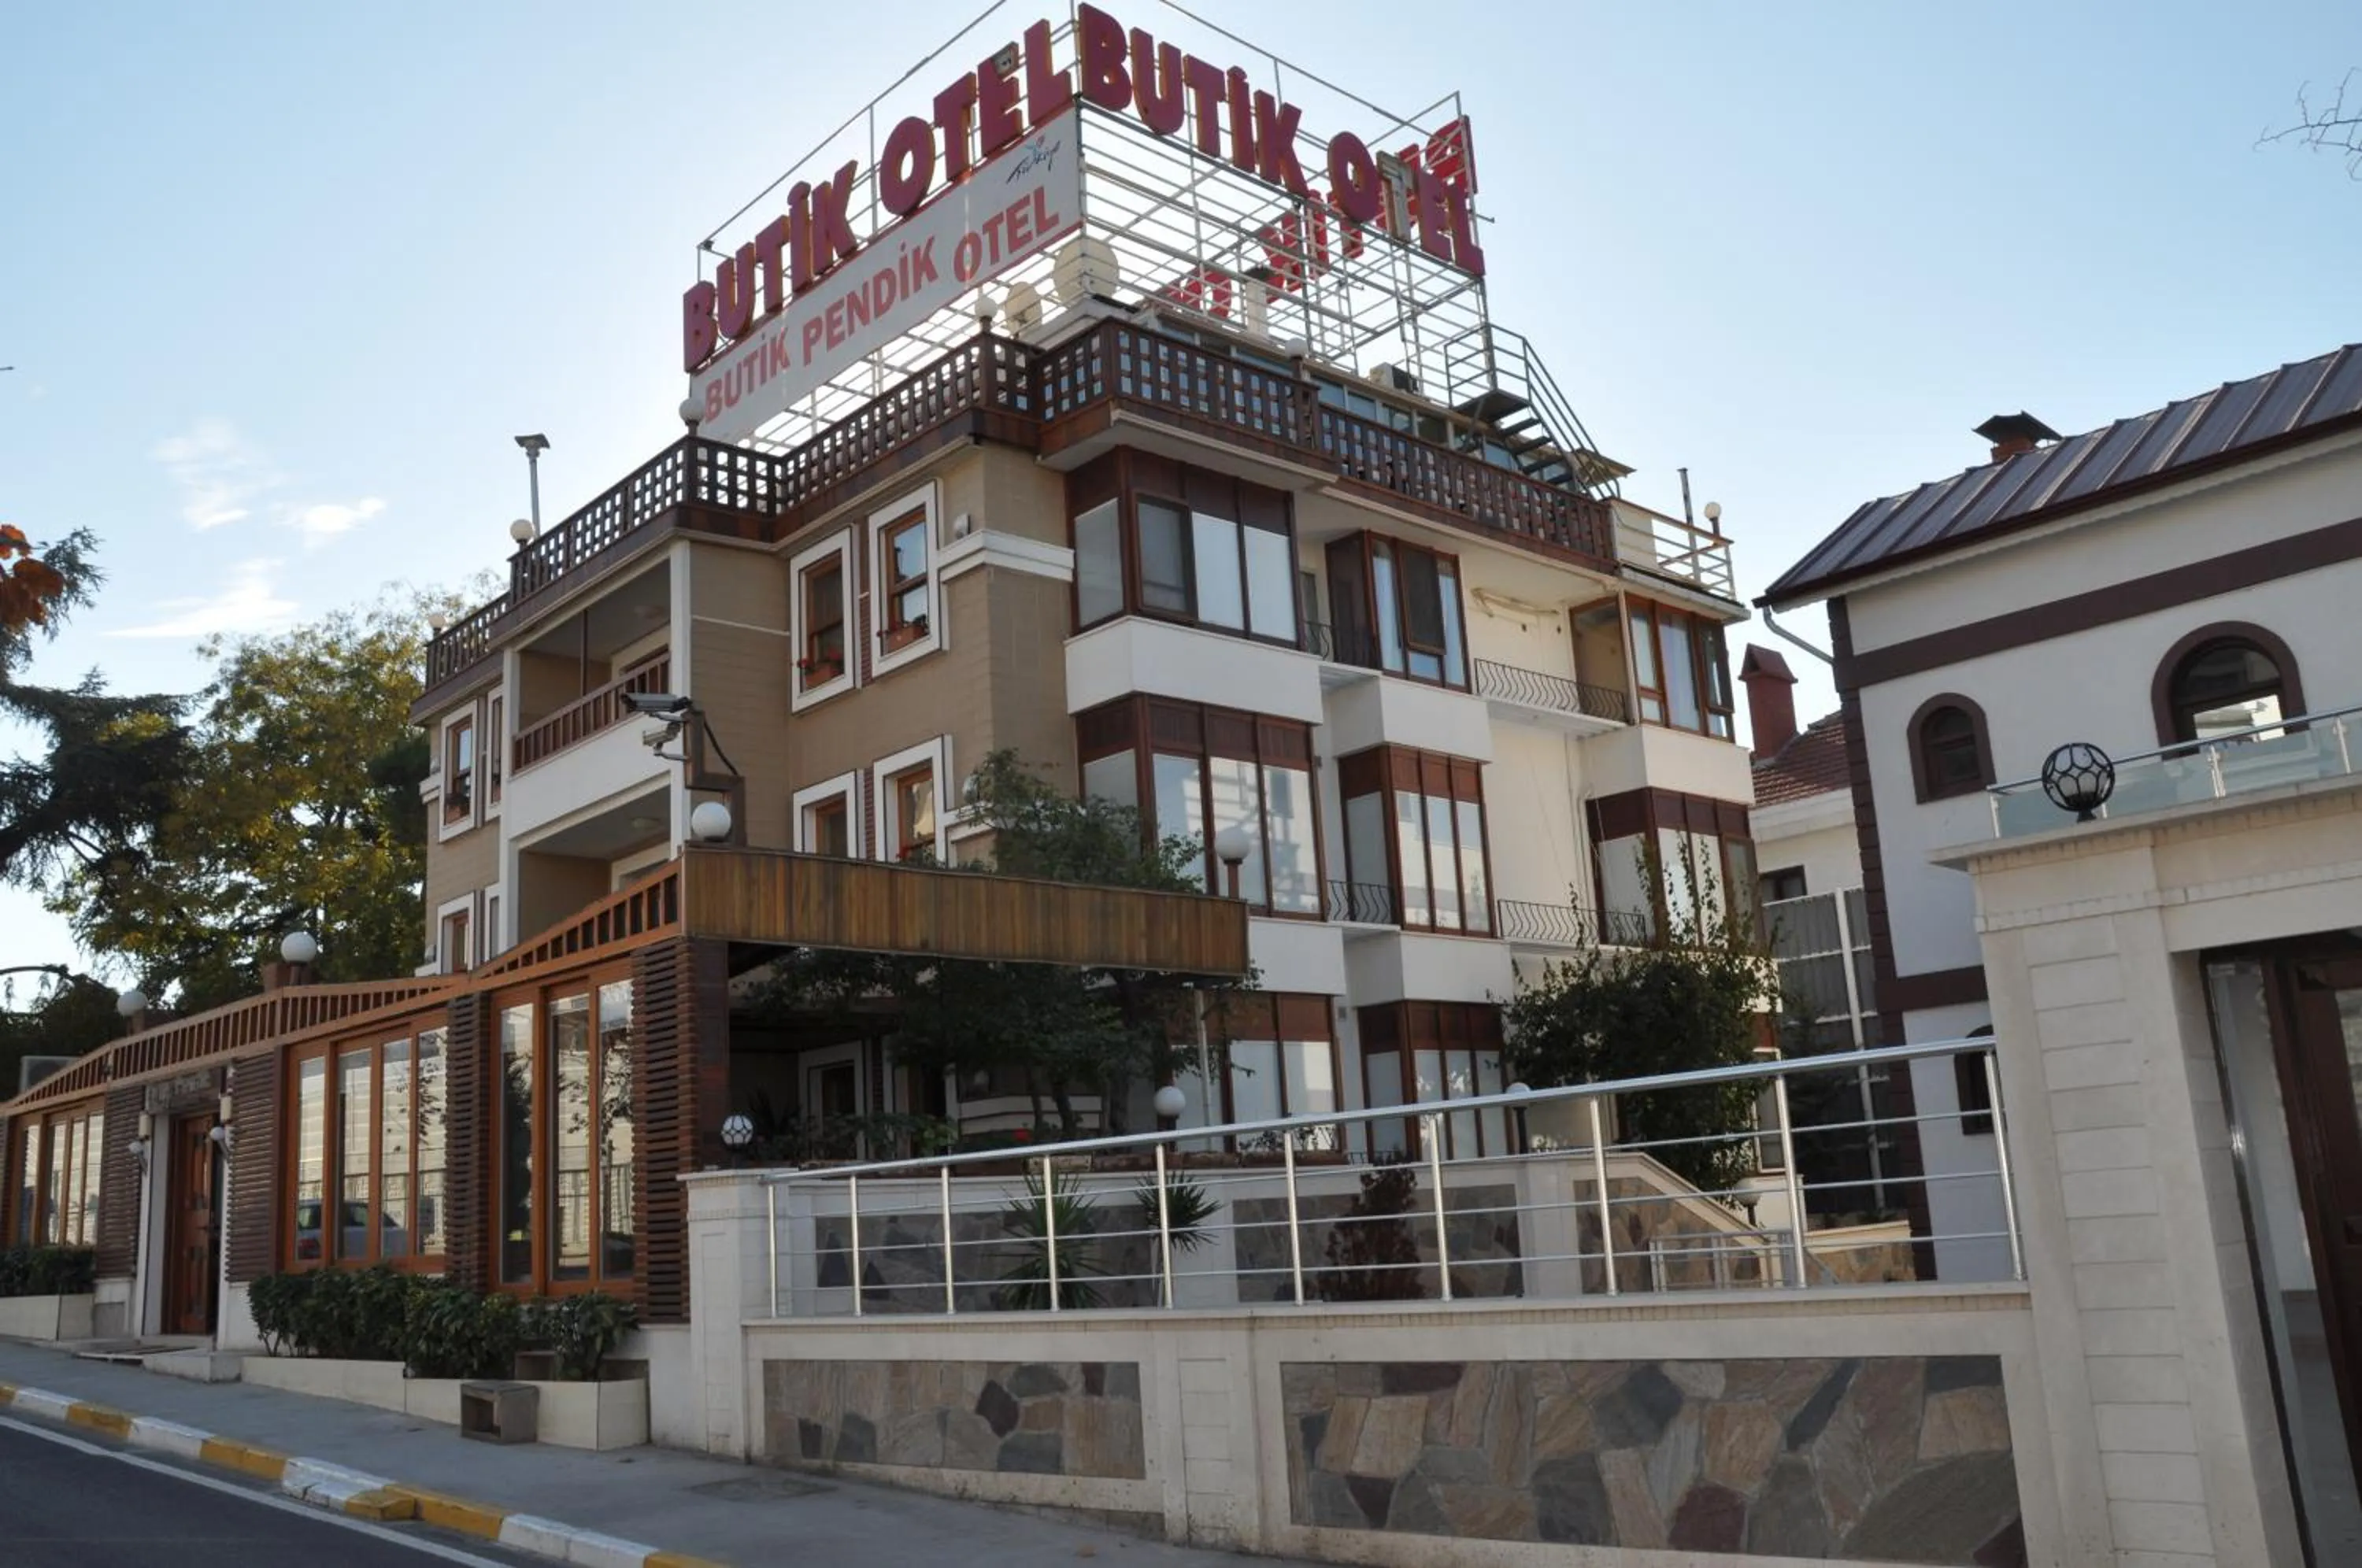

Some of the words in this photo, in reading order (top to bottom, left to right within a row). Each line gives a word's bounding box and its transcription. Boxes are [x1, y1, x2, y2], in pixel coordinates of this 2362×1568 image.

[683, 160, 859, 373] BUTİK
[879, 18, 1072, 216] OTEL
[1078, 2, 1310, 198] BUTİK
[1327, 131, 1486, 276] OTEL
[704, 326, 790, 423] BUTİK
[802, 235, 939, 366] PENDİK
[953, 186, 1060, 283] OTEL
